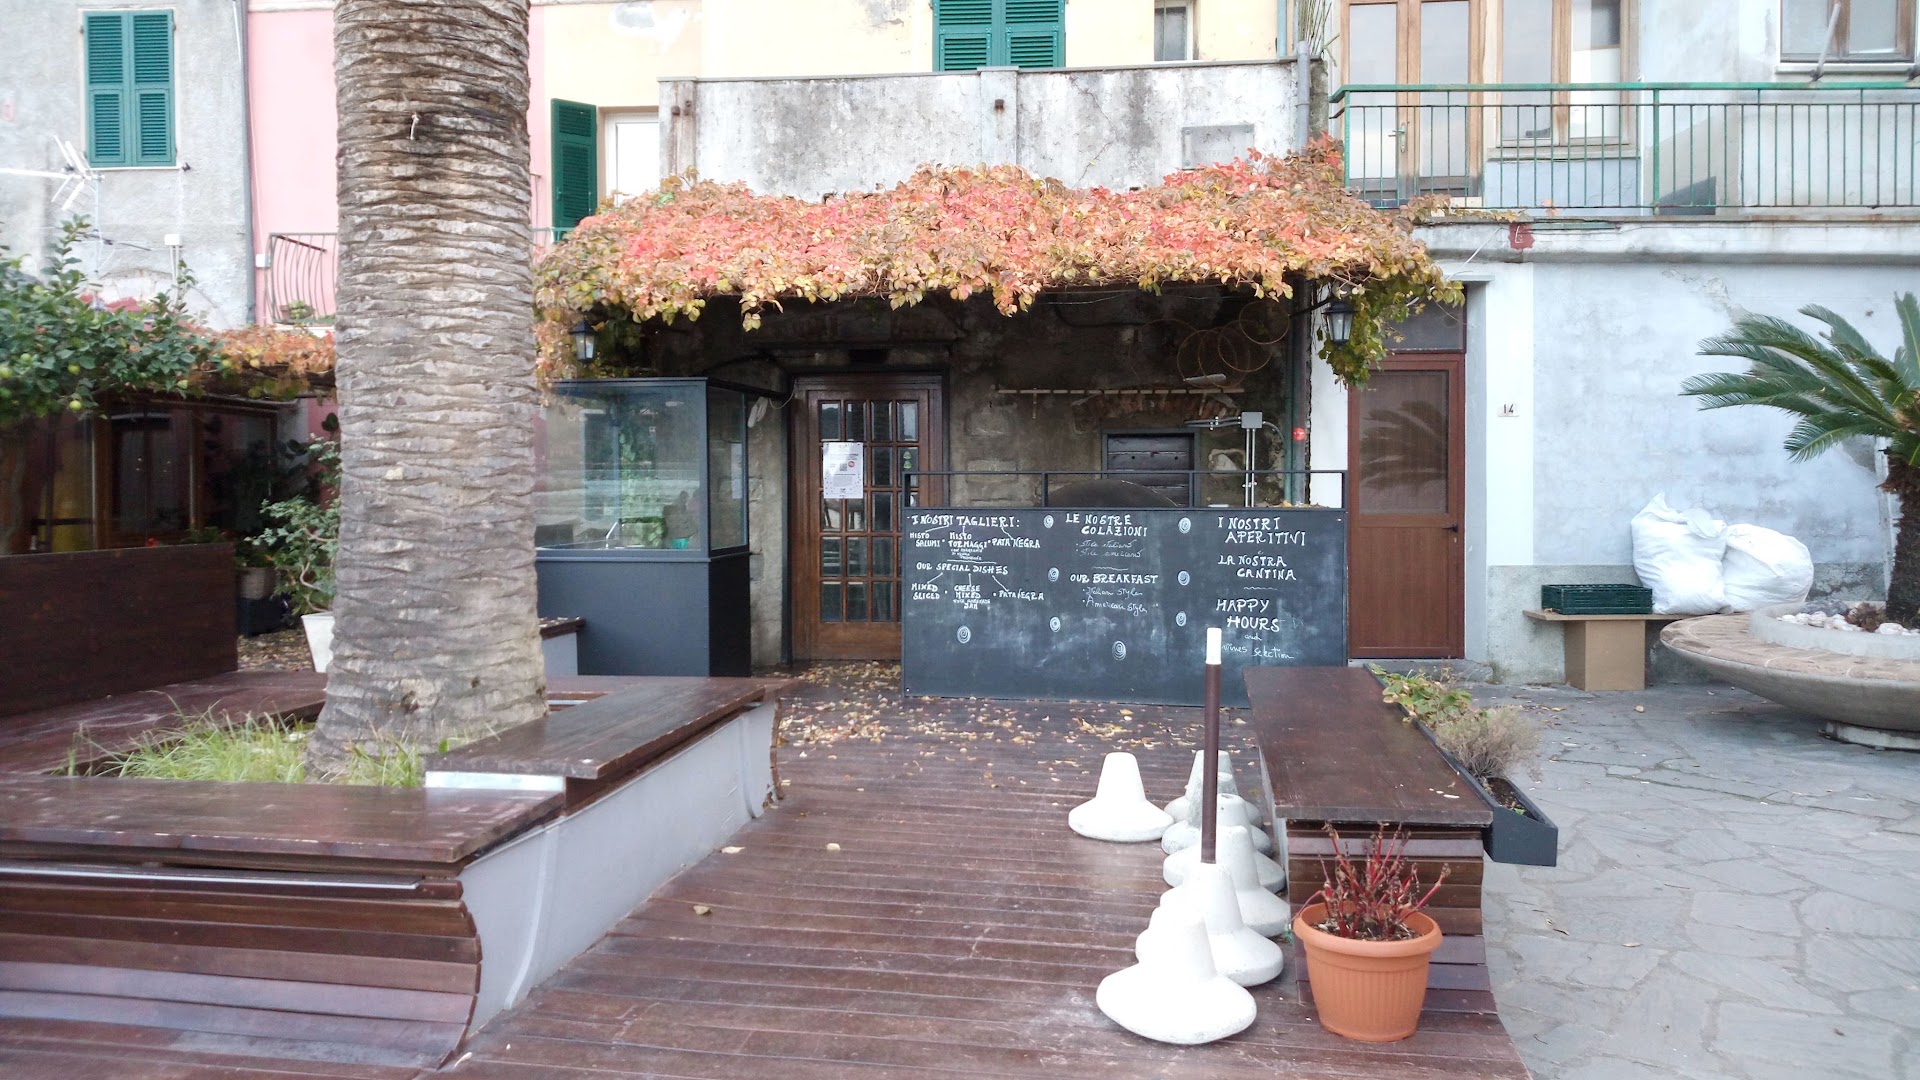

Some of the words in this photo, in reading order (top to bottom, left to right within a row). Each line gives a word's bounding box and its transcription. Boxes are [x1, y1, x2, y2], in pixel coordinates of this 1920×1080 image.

[919, 514, 954, 526] NOSTRI
[1065, 513, 1080, 524] LE
[1085, 514, 1132, 526] NOSTRE
[1218, 516, 1224, 528] I
[1228, 517, 1281, 531] NOSTRI
[1081, 525, 1148, 537] COLAZIONI
[1012, 537, 1041, 549] NEGRA
[1224, 530, 1306, 546] APERITIVI
[1217, 555, 1236, 566] LA
[1238, 555, 1288, 568] NOSTRA
[916, 561, 933, 571] OUR
[935, 562, 971, 572] SPECIAL
[972, 564, 1009, 576] DISHES
[1236, 567, 1297, 581] CANTINA
[1070, 573, 1090, 584] OUR
[1092, 573, 1159, 585] BREAKFAST
[912, 592, 941, 600] SLICED
[1215, 598, 1270, 613] HAPPY
[1226, 615, 1281, 633] HOURS
